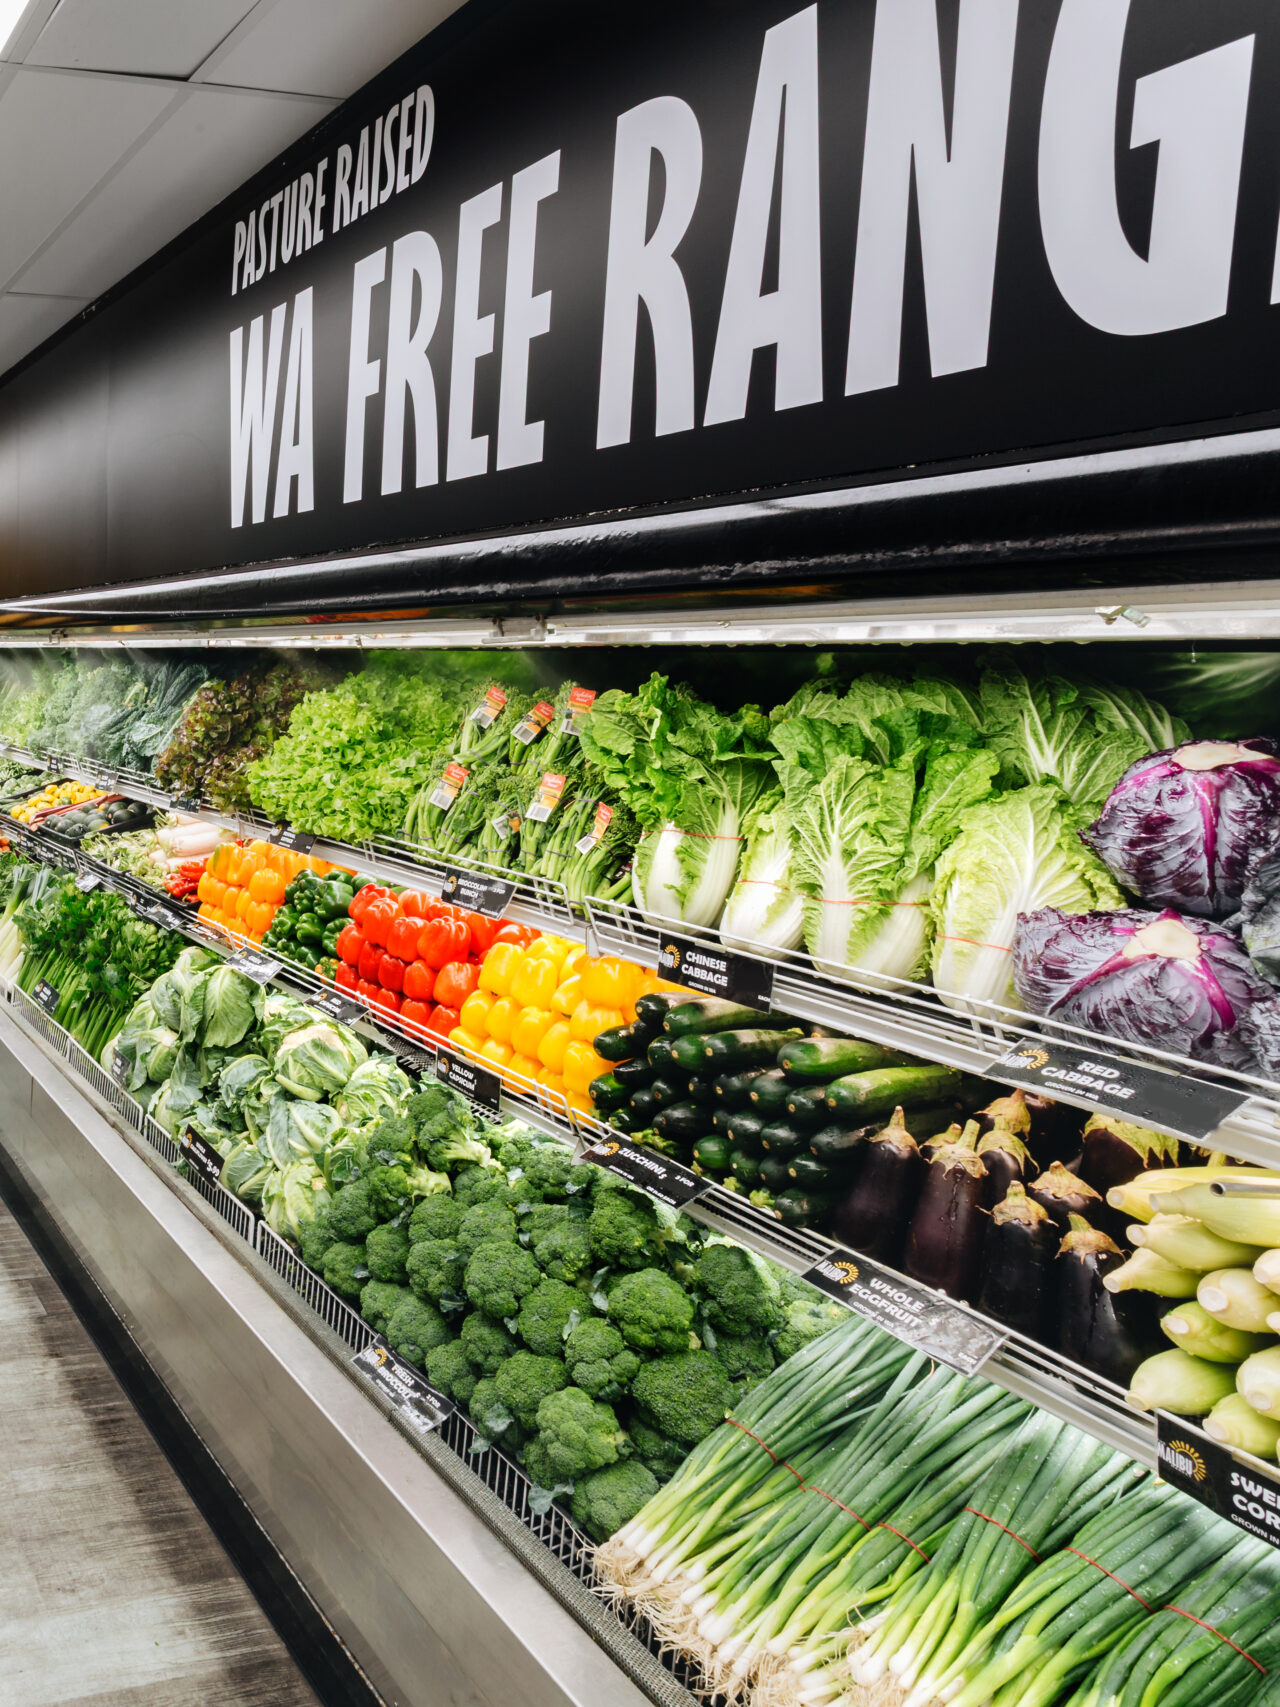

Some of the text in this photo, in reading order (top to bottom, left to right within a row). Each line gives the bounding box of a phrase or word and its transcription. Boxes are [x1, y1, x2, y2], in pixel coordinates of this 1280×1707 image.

[231, 84, 435, 296] PASTURE RAISED
[230, 0, 1280, 529] WA FREE RANG
[681, 964, 728, 987] CABBAGE
[685, 951, 727, 972] CHINESE
[1041, 1066, 1135, 1099] CABBAGE
[1077, 1061, 1120, 1079] RED
[1045, 1081, 1075, 1093] GROWN
[617, 1147, 666, 1175] ZUCCHINI
[848, 1283, 922, 1328] EGGFRUIT
[853, 1301, 879, 1318] GROWN
[870, 1277, 925, 1312] WHOLE
[392, 1364, 415, 1387] FRESH
[1158, 1442, 1193, 1475] MALIBU
[1231, 1513, 1280, 1545] GROWN IN
